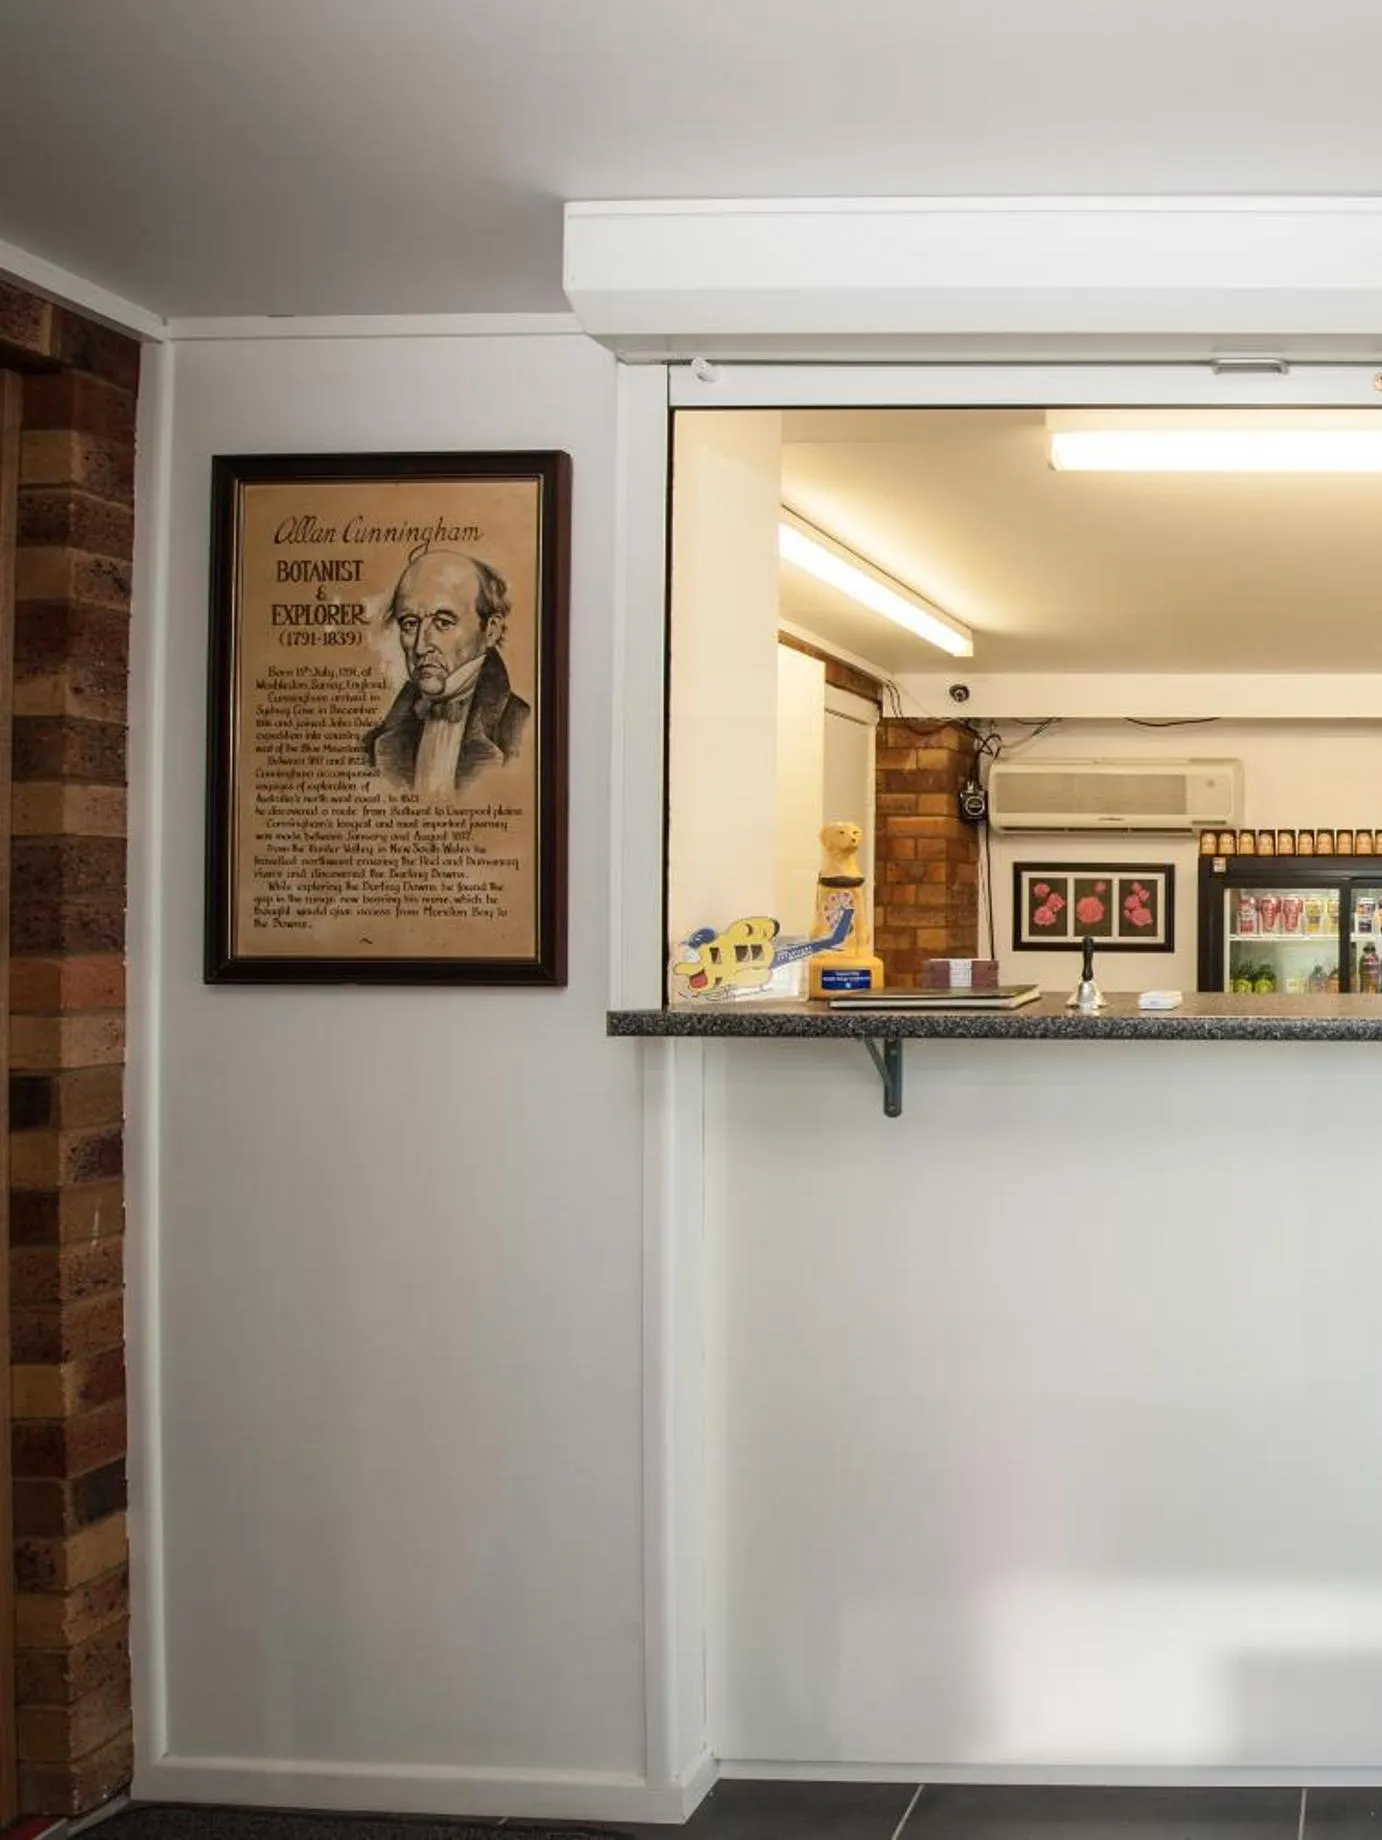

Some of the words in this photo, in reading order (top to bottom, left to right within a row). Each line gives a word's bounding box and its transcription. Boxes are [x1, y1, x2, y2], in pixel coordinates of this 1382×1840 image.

[273, 515, 336, 544] Allan
[342, 516, 484, 550] Cunningham
[276, 560, 364, 582] BOTANIST
[315, 584, 327, 601] &
[271, 604, 371, 626] EXPLORER
[279, 629, 362, 647] (1791-1839)
